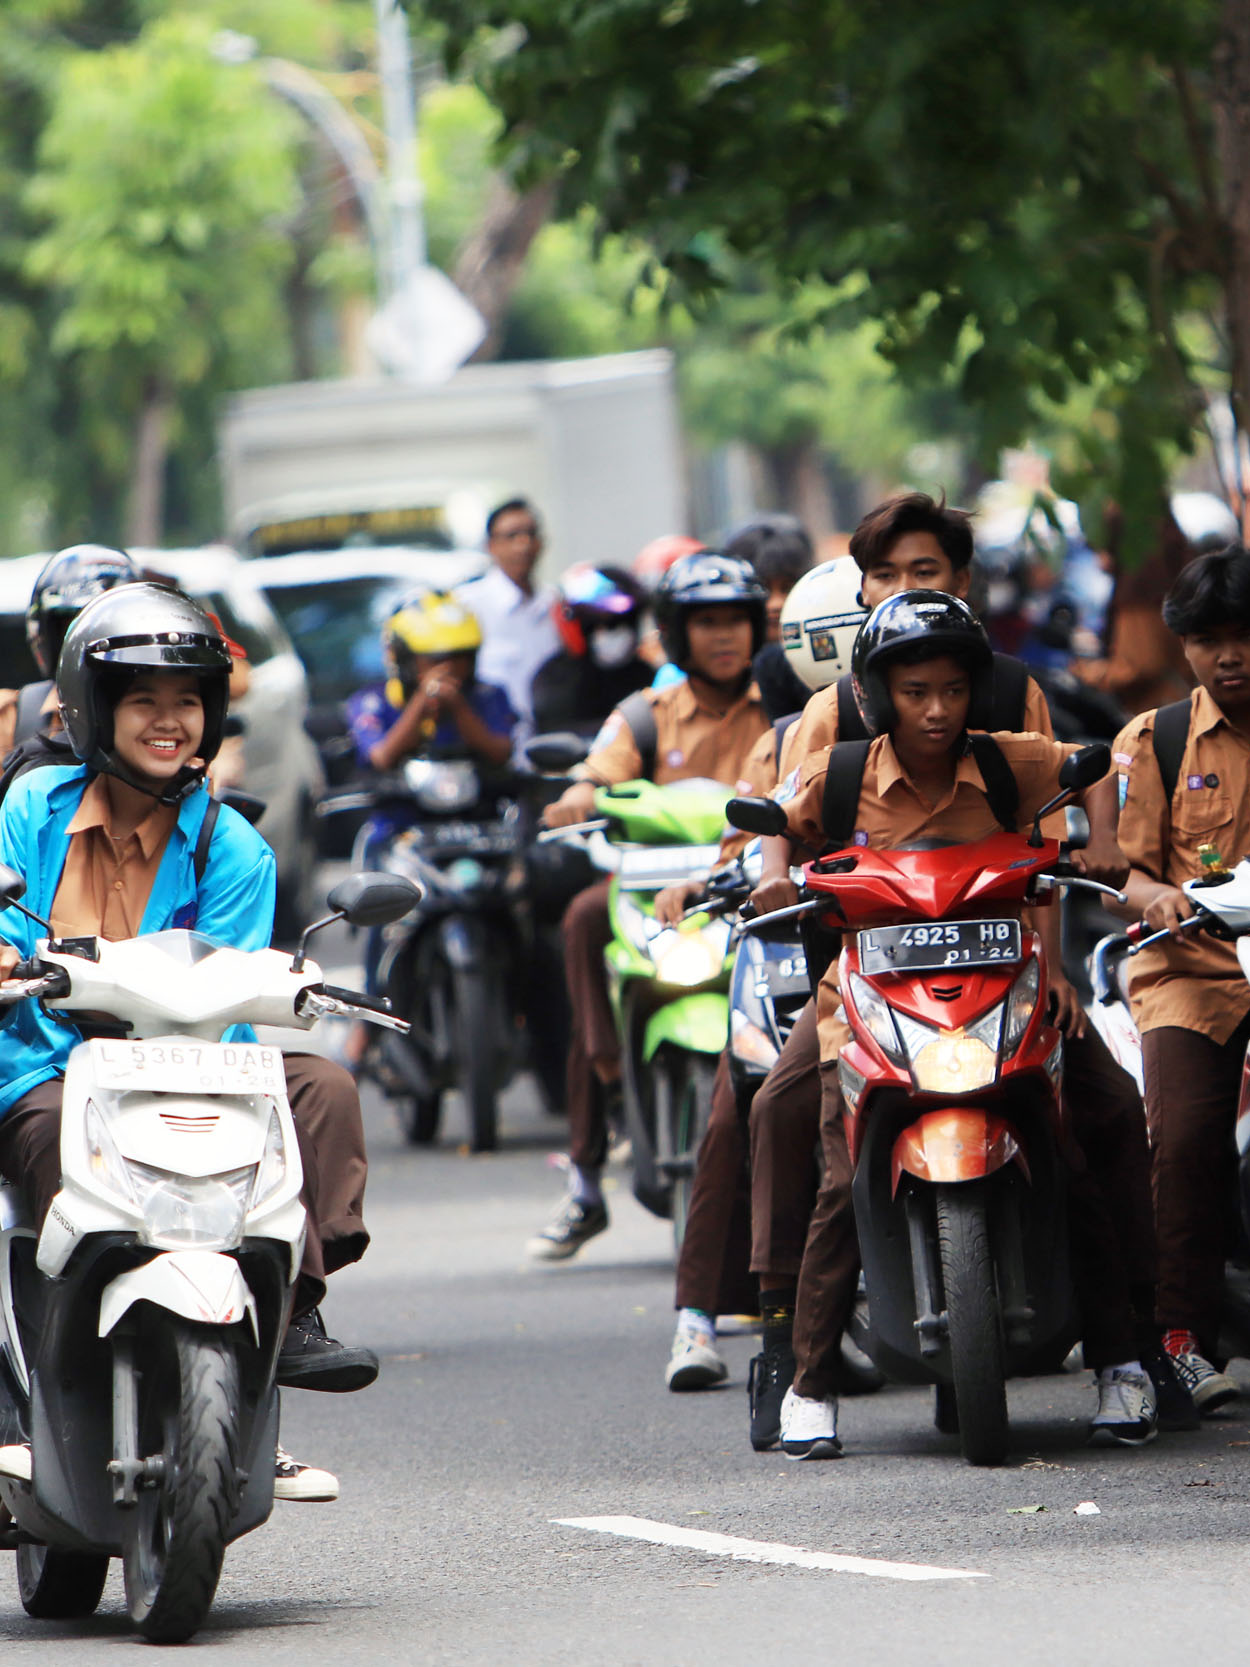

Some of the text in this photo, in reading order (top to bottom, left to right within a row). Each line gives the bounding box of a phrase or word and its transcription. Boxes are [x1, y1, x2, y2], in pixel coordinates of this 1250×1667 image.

[866, 933, 881, 952] L
[899, 925, 961, 947] 4925
[100, 1043, 275, 1070] L 5367 DAB
[51, 1205, 76, 1237] HONDA
